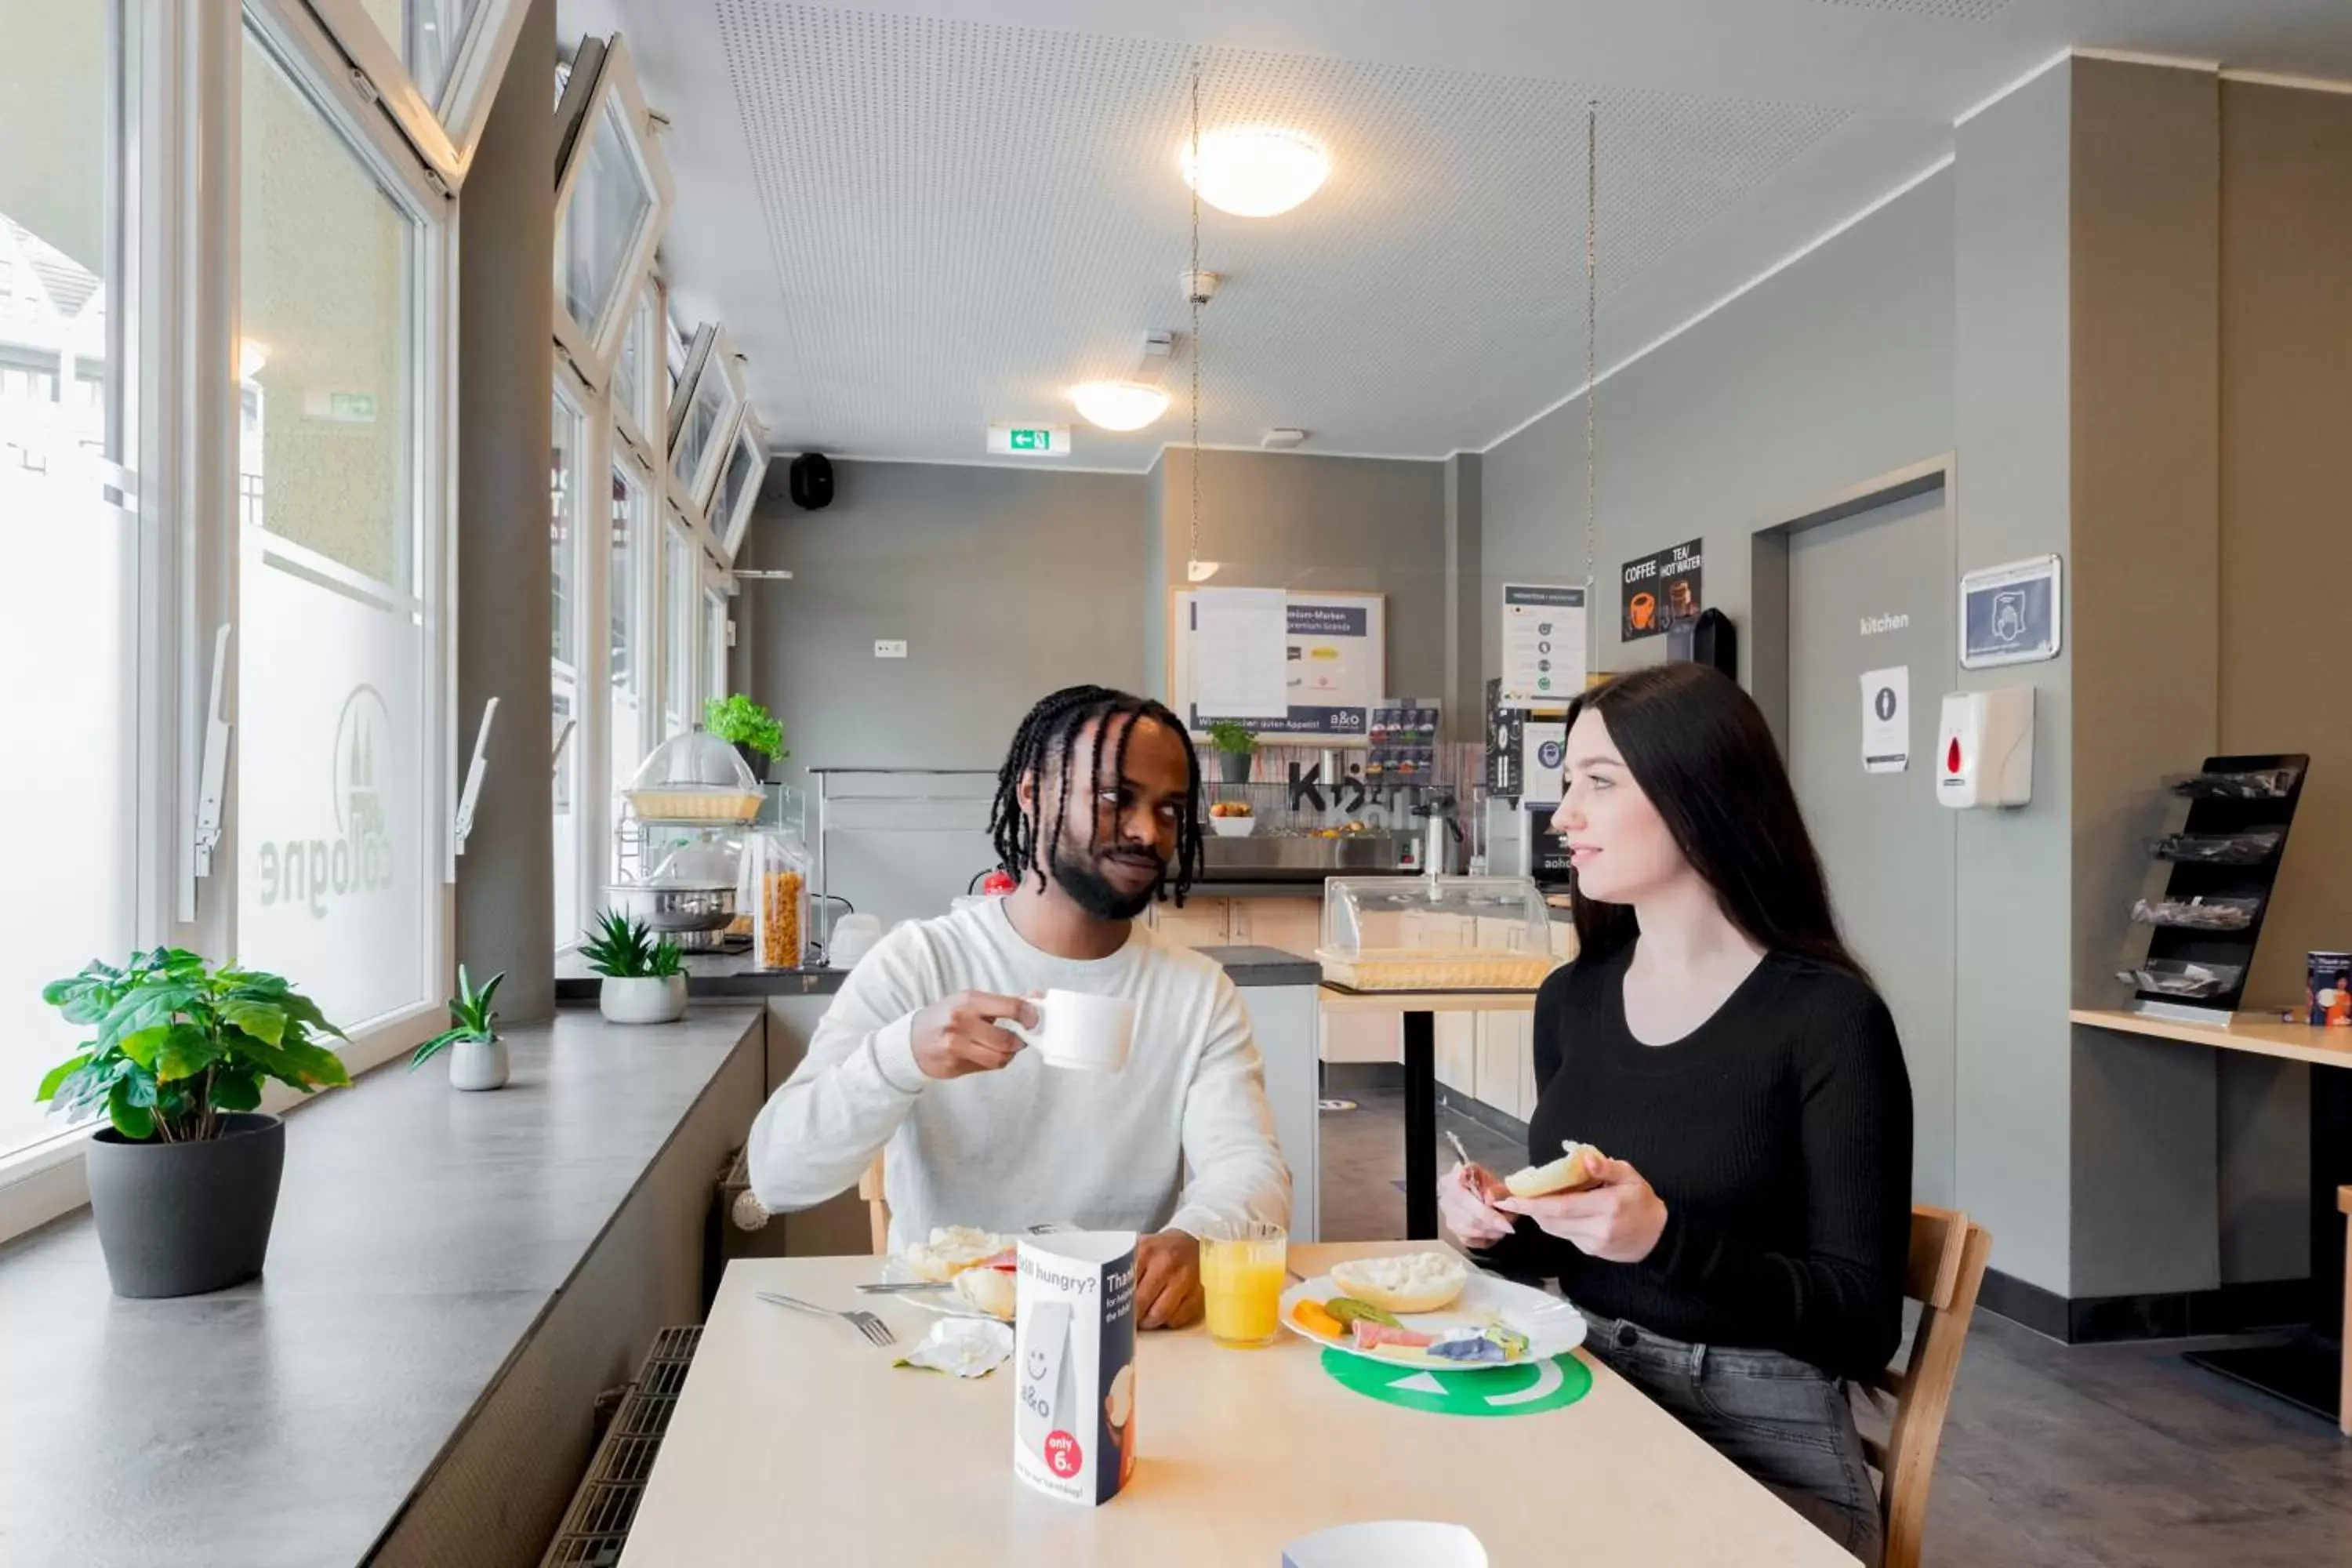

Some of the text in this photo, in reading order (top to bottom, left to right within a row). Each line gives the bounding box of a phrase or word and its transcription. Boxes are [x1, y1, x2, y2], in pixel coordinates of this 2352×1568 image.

[1625, 560, 1657, 583] COFFEE
[1677, 554, 1700, 573] WATER
[1860, 612, 1908, 636] kitchen
[1330, 711, 1360, 725] a&o
[1036, 1262, 1096, 1294] hungry?
[1022, 1385, 1050, 1418] a&o
[1049, 1436, 1073, 1454] only
